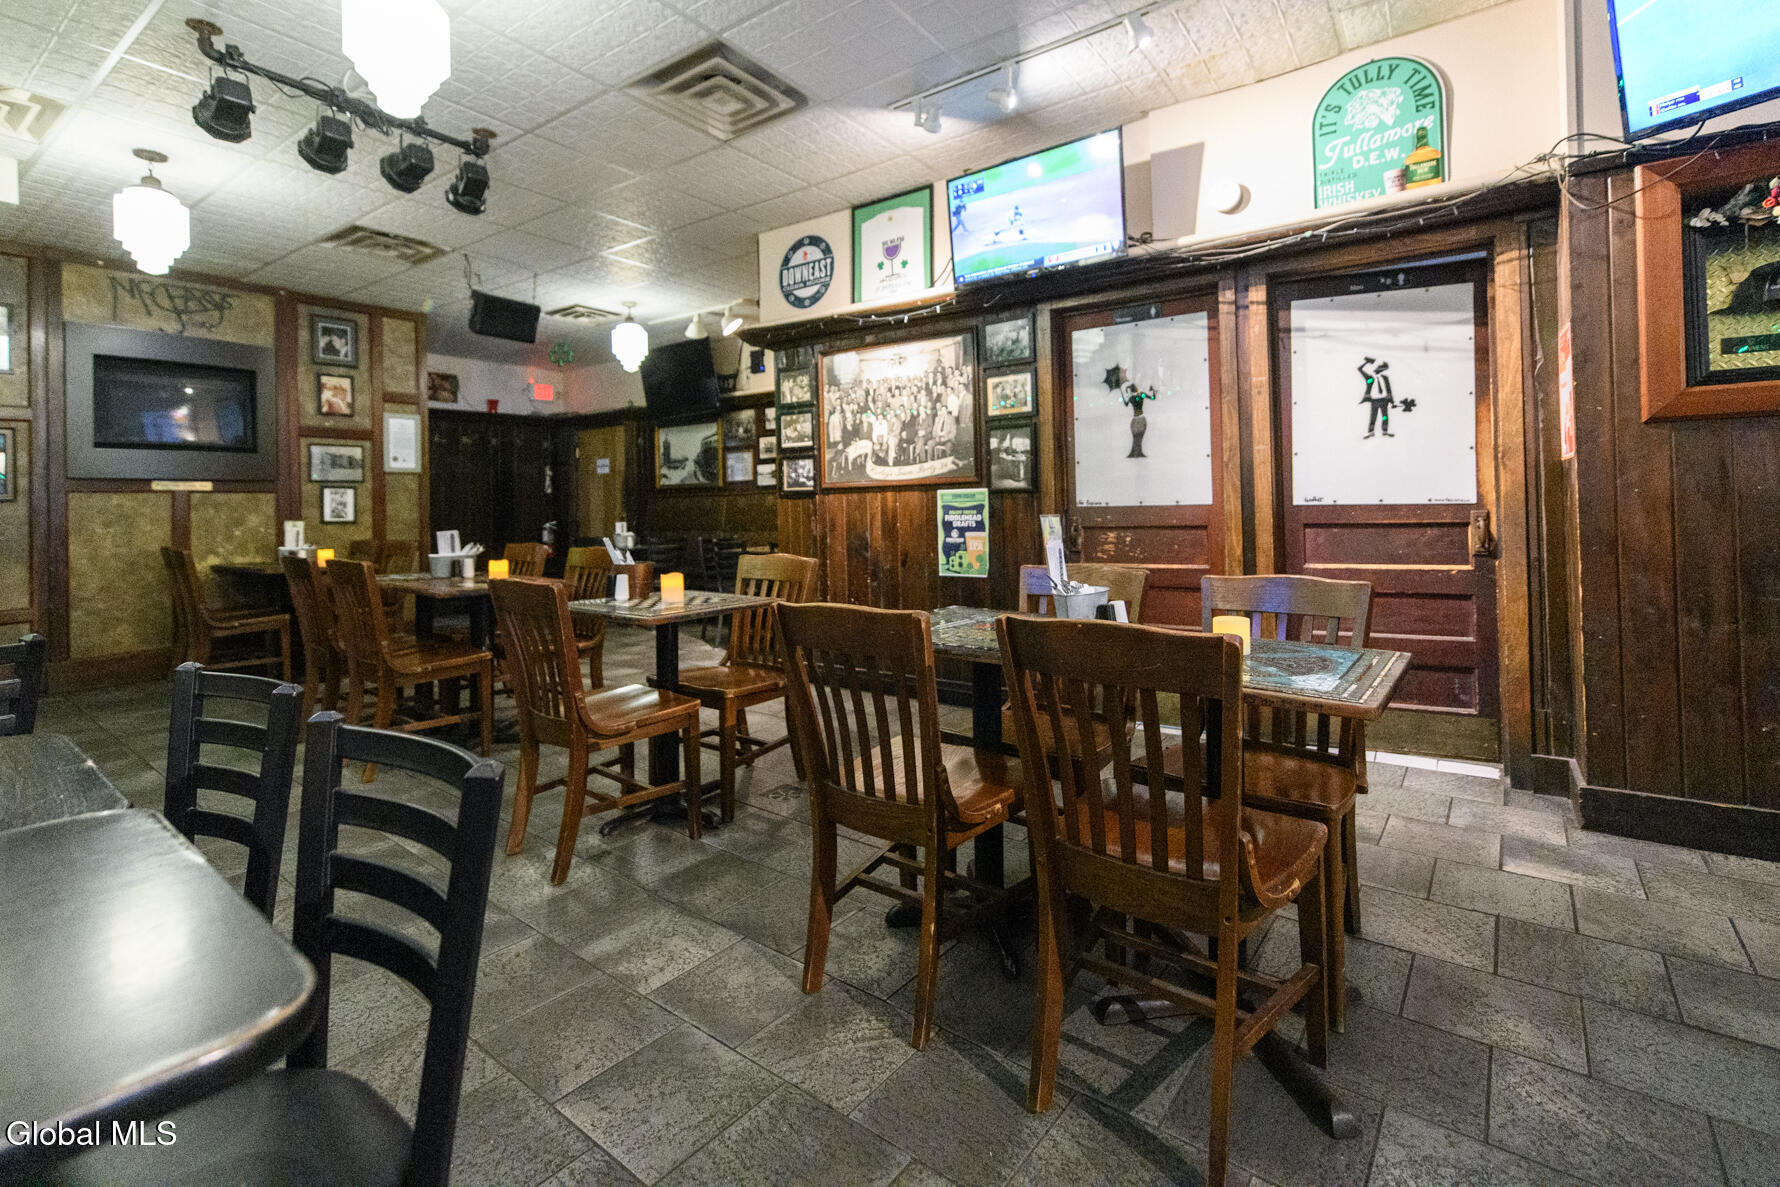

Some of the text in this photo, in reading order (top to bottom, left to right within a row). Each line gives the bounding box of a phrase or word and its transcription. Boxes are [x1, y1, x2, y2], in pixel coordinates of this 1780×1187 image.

[1319, 63, 1435, 137] IT'S TULLY TIME
[1318, 115, 1435, 170] Tullamore
[1352, 147, 1406, 169] D.E.W.
[1318, 180, 1355, 199] IRISH
[1318, 187, 1381, 208] WHISKEY
[782, 257, 832, 286] DOWNEAST
